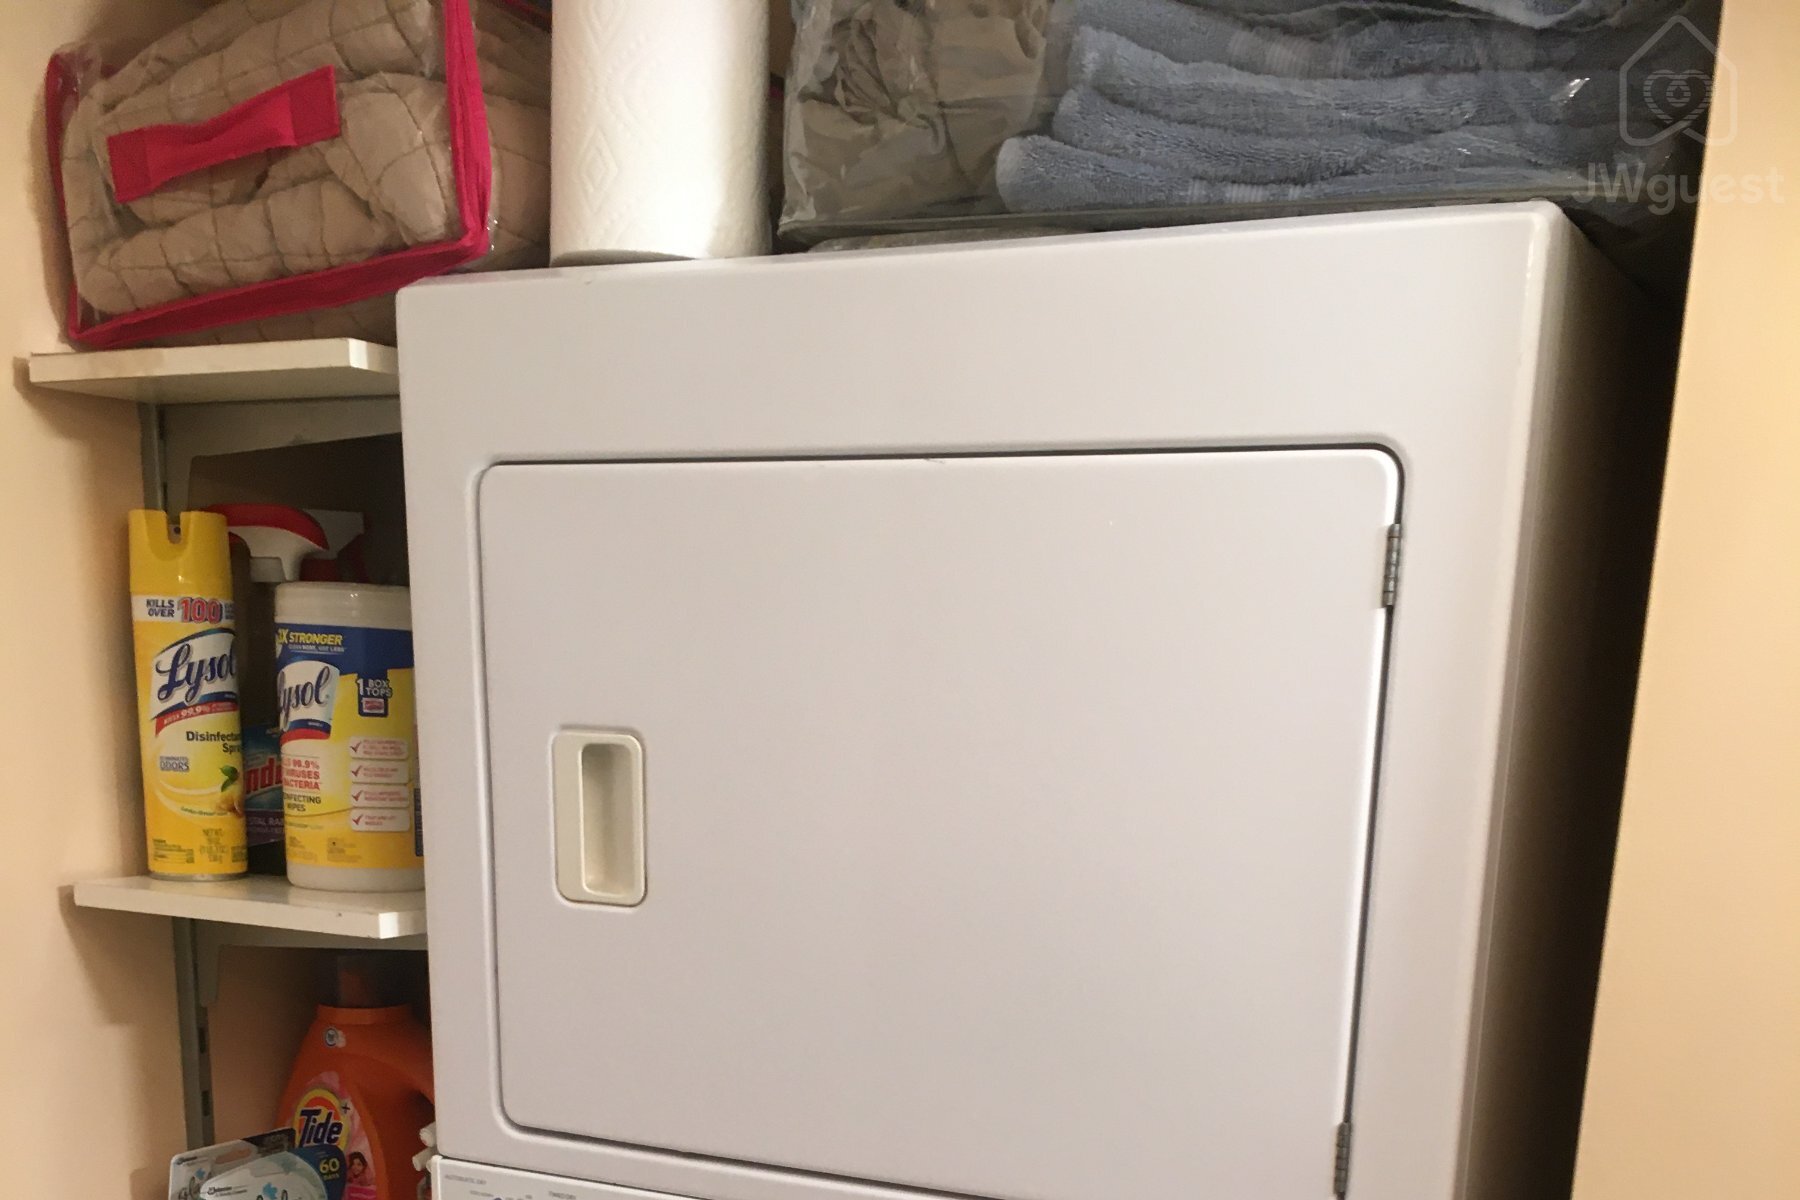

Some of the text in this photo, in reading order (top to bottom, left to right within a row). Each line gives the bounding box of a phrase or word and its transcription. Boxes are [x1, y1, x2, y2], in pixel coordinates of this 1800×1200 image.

[145, 598, 175, 608] KILLS
[179, 597, 223, 623] 100
[148, 608, 175, 618] OVER
[289, 631, 343, 646] STRONGER
[357, 678, 389, 696] 1 BOX
[366, 686, 392, 697] TOPS
[300, 1108, 343, 1148] Tide
[319, 1158, 340, 1174] 60
